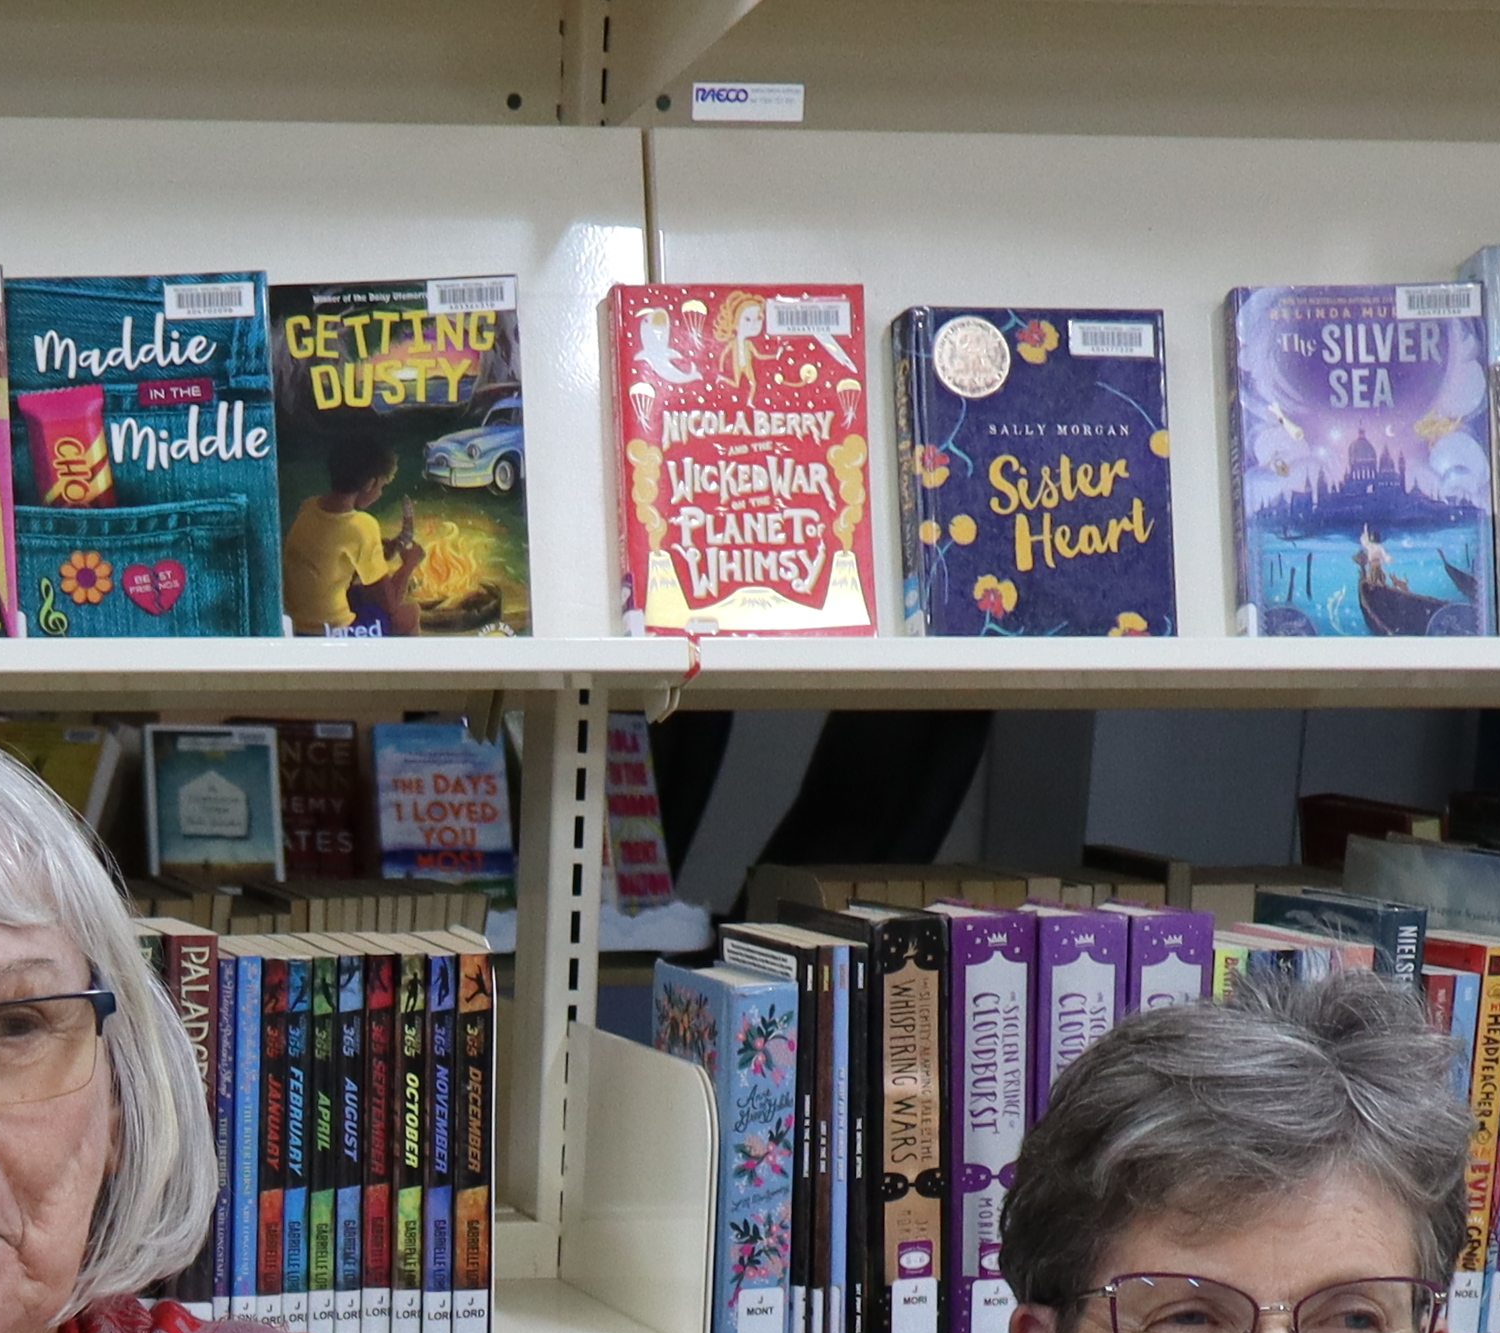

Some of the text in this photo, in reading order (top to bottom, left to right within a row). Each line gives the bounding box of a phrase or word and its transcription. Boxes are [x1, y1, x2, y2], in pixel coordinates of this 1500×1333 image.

[695, 88, 748, 102] RAECO
[286, 310, 497, 359] GETTING
[1270, 309, 1351, 321] BELINDA
[33, 313, 217, 379] Maddie
[1278, 323, 1443, 365] The SILVER
[149, 386, 202, 399] IN THE
[311, 359, 472, 410] DUSTY
[1329, 370, 1394, 409] SEA
[111, 400, 270, 471] Middle
[662, 410, 834, 450] NICOLA BERRY
[728, 441, 773, 455] AND THE
[989, 423, 1129, 437] SALLY MORGAN
[667, 455, 836, 511] WICKED WAR
[731, 496, 770, 509] ON THE
[989, 453, 1129, 516] Sister
[669, 507, 825, 546] PLANET OF
[1013, 501, 1155, 570] Heart
[671, 542, 826, 598] WHIMSY
[323, 620, 382, 637] Jared
[392, 773, 498, 797] THE DAYS
[412, 801, 498, 823] LOVED
[421, 826, 477, 849] YOU
[416, 850, 487, 872] MOST
[889, 978, 917, 1164] WHISPERING WARS
[971, 992, 1000, 1134] CLOUDBURST
[289, 1067, 304, 1176] FEBRUARY
[344, 1077, 360, 1163] AUGUST
[404, 1073, 421, 1168] OCTOBER
[434, 1065, 450, 1175] NOVEMBER
[467, 1067, 482, 1175] DECEMBER
[455, 1307, 486, 1319] LORD
[747, 1306, 774, 1316] MONT
